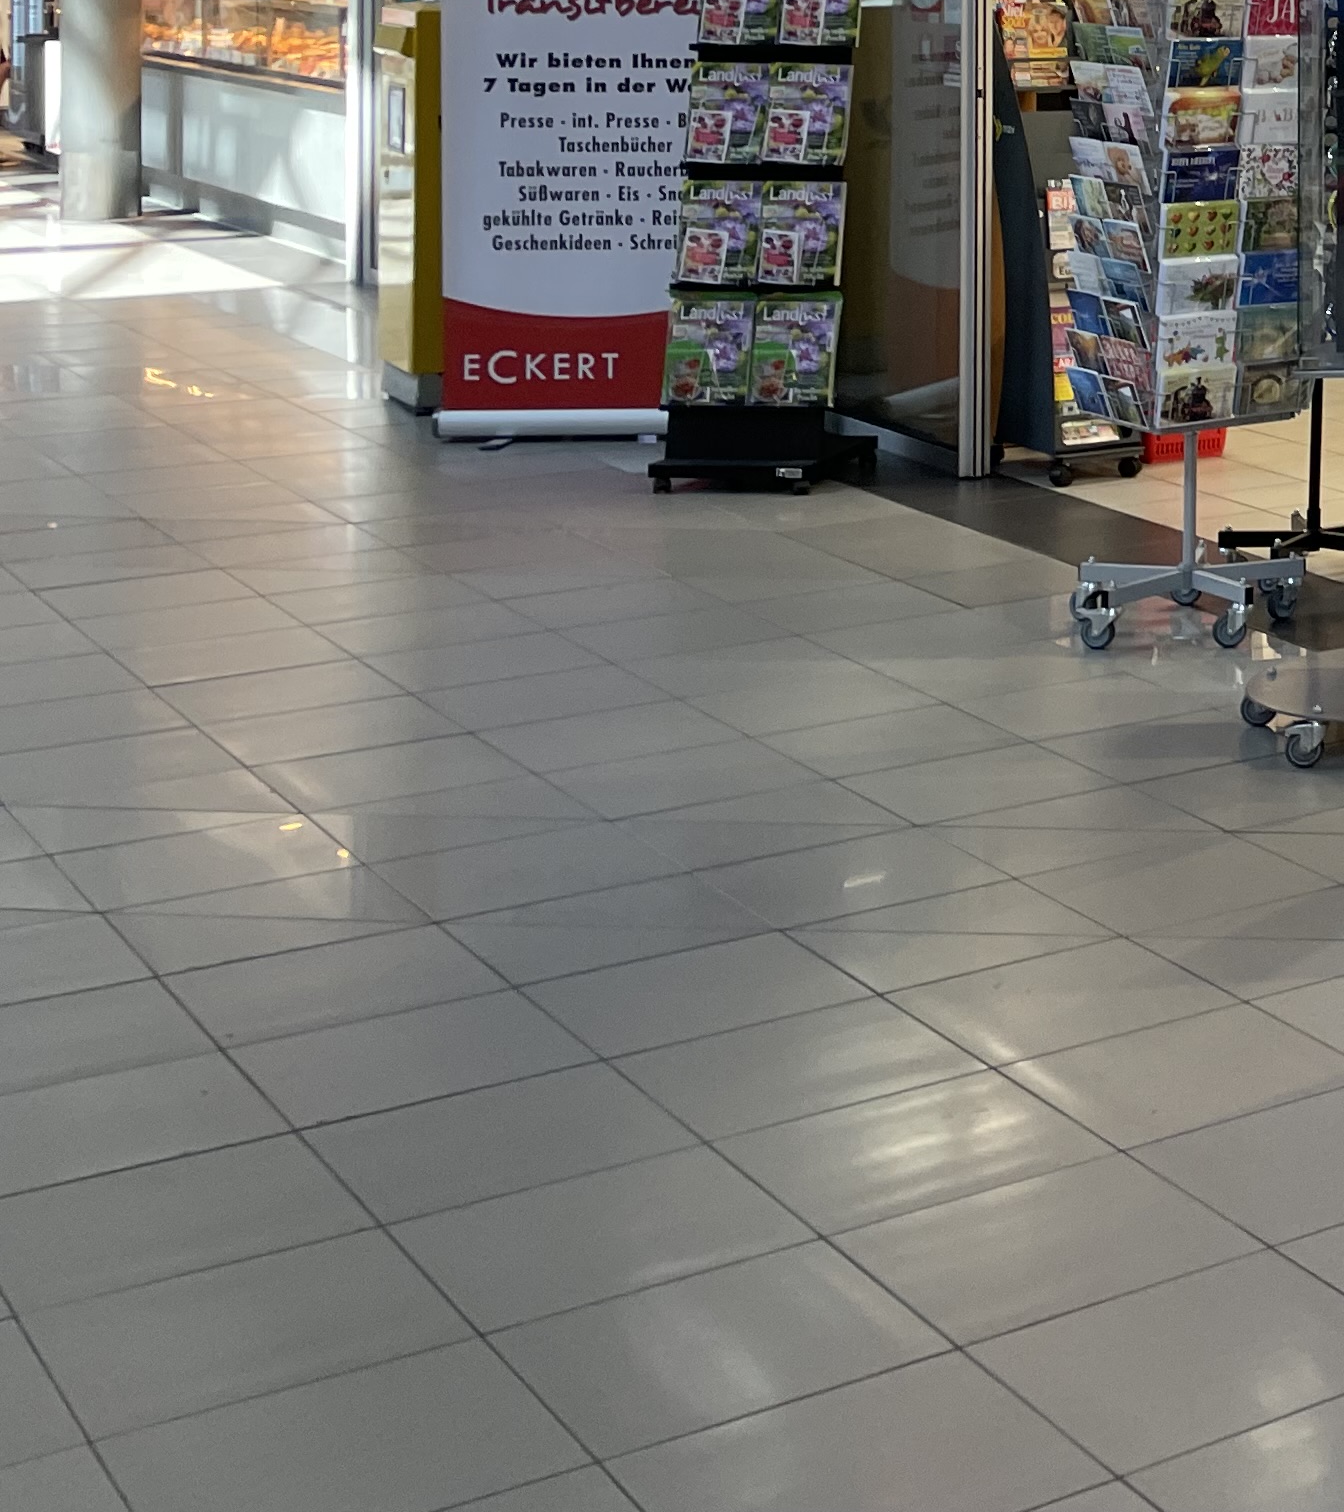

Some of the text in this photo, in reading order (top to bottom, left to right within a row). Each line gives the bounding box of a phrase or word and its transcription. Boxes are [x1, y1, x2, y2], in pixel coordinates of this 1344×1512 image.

[496, 52, 698, 69] Wir bieten Ihnen
[483, 78, 497, 93] 7
[507, 77, 576, 97] Tagen
[586, 77, 607, 93] in
[617, 77, 656, 93] der
[500, 112, 554, 129] Presse
[572, 112, 600, 129] int.
[606, 112, 660, 129] Presse
[558, 136, 673, 153] Taschenbücher
[499, 161, 689, 178] Tabakwaren Raucherb
[518, 185, 640, 202] Süßwaren Eis
[483, 209, 634, 231] gekühlte Getränke
[492, 234, 678, 251] Geschenkideen Schrei
[463, 349, 620, 385] ECKERT
